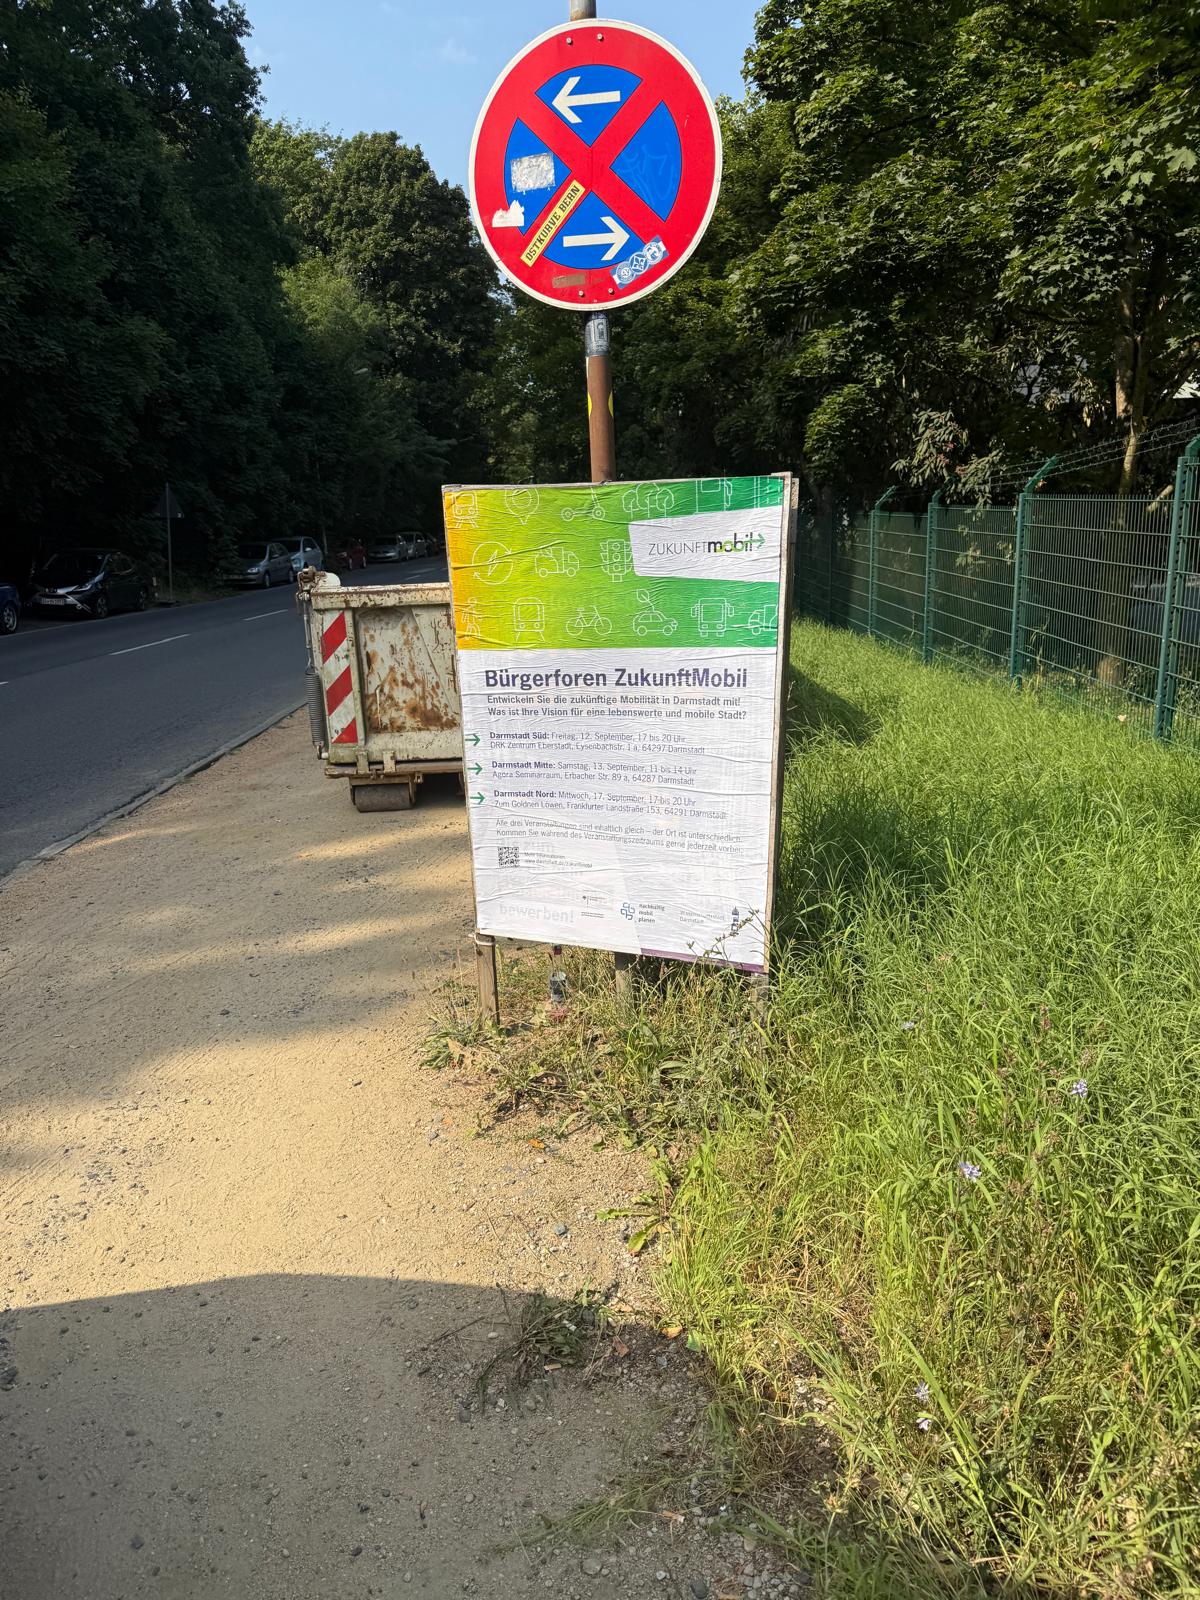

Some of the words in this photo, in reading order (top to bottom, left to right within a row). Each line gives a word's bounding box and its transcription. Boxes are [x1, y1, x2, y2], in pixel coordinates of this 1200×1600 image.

[525, 212, 561, 261] OSTKURVE
[558, 184, 581, 210] BERN
[648, 531, 753, 556] ZUKUNFTmobil
[485, 668, 607, 690] Bürgerforen
[614, 668, 748, 688] ZukunftMobil
[487, 695, 534, 704] Entwickeln
[536, 695, 551, 704] Sie
[553, 695, 567, 704] die
[570, 694, 618, 705] zukünftige
[620, 695, 660, 704] Mobilität
[662, 696, 670, 704] in
[673, 696, 721, 706] Darmstadt
[723, 697, 741, 706] mit!
[488, 708, 506, 716] Was
[508, 707, 519, 716] ist
[521, 708, 539, 716] Ihre
[541, 708, 568, 716] Vision
[570, 708, 583, 716] für
[586, 708, 605, 717] eine
[608, 708, 663, 717] lebenswerte
[665, 709, 682, 718] und
[684, 710, 715, 719] mobile
[718, 711, 747, 720] Stadt?
[490, 732, 530, 740] Darmstadt
[532, 731, 550, 740] Süd:
[551, 732, 578, 741] Freitag,
[580, 732, 591, 740] 12.
[594, 732, 635, 743] September,
[638, 733, 647, 742] 17
[650, 733, 660, 742] bis
[661, 733, 672, 742] 20
[673, 733, 686, 743] Uhr
[490, 741, 506, 749] DRK
[507, 741, 537, 749] Zentrum
[538, 742, 574, 751] Eberstadt,
[642, 744, 666, 752] 64297
[668, 745, 705, 754] Darmstadt
[492, 760, 532, 769] Darmstadt
[534, 761, 556, 769] Mitte:
[557, 762, 591, 771] Samstag,
[593, 762, 604, 771] 13.
[607, 763, 647, 773] September,
[650, 764, 658, 773] 11
[660, 765, 671, 774] bis
[674, 766, 684, 774] 14
[685, 766, 697, 775] Uhr
[492, 771, 513, 780] Agora
[515, 771, 563, 780] Seminarraum,
[564, 771, 595, 780] Erbacher
[598, 772, 610, 781] Str.
[611, 773, 622, 781] 89
[632, 773, 656, 783] 64287
[658, 775, 695, 785] Darmstadt
[494, 790, 534, 798] Darmstadt
[535, 790, 557, 798] Nord:
[558, 791, 591, 800] Mittwoch,
[593, 792, 605, 801] 17.
[607, 793, 647, 803] September,
[650, 795, 658, 804] 17
[660, 796, 671, 805] bis
[672, 796, 683, 805] 20
[684, 797, 696, 806] Uhr
[495, 800, 510, 808] Zum
[540, 800, 565, 810] Löwen,
[566, 802, 604, 810] Frankfurter
[606, 803, 644, 814] Landstraße
[646, 805, 661, 815] 153,
[664, 807, 687, 816] 64291
[689, 809, 726, 820] Darmstadt
[510, 819, 523, 827] drei
[579, 823, 592, 831] sind
[594, 824, 623, 833] inhaltlich
[624, 826, 645, 835] gleich
[652, 828, 663, 836] der
[665, 829, 676, 838] Ort
[679, 830, 687, 838] ist
[496, 829, 526, 837] Kommen
[528, 829, 539, 837] Sie
[541, 830, 569, 839] während
[570, 831, 583, 840] des
[665, 840, 686, 849] gerne
[687, 841, 717, 852] jederzeit
[639, 903, 665, 912] nachhaltig
